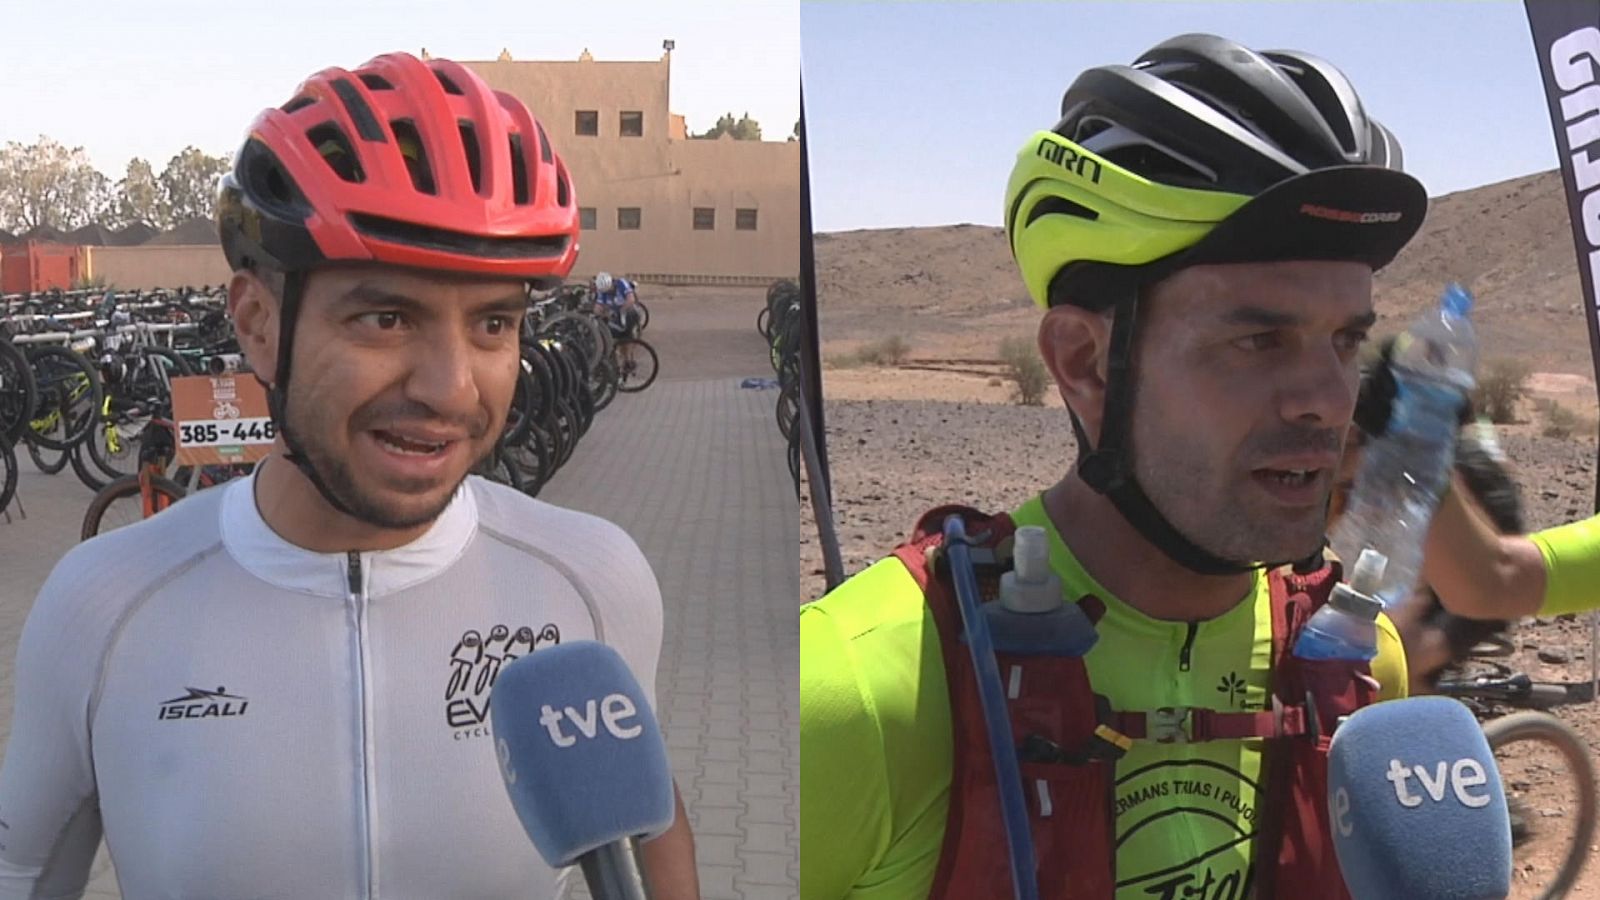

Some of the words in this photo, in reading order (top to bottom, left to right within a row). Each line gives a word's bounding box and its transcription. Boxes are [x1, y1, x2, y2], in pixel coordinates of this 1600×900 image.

[181, 421, 275, 443] 385-448
[158, 701, 248, 720] ISCALI
[539, 693, 642, 747] tve
[1386, 758, 1491, 807] tve
